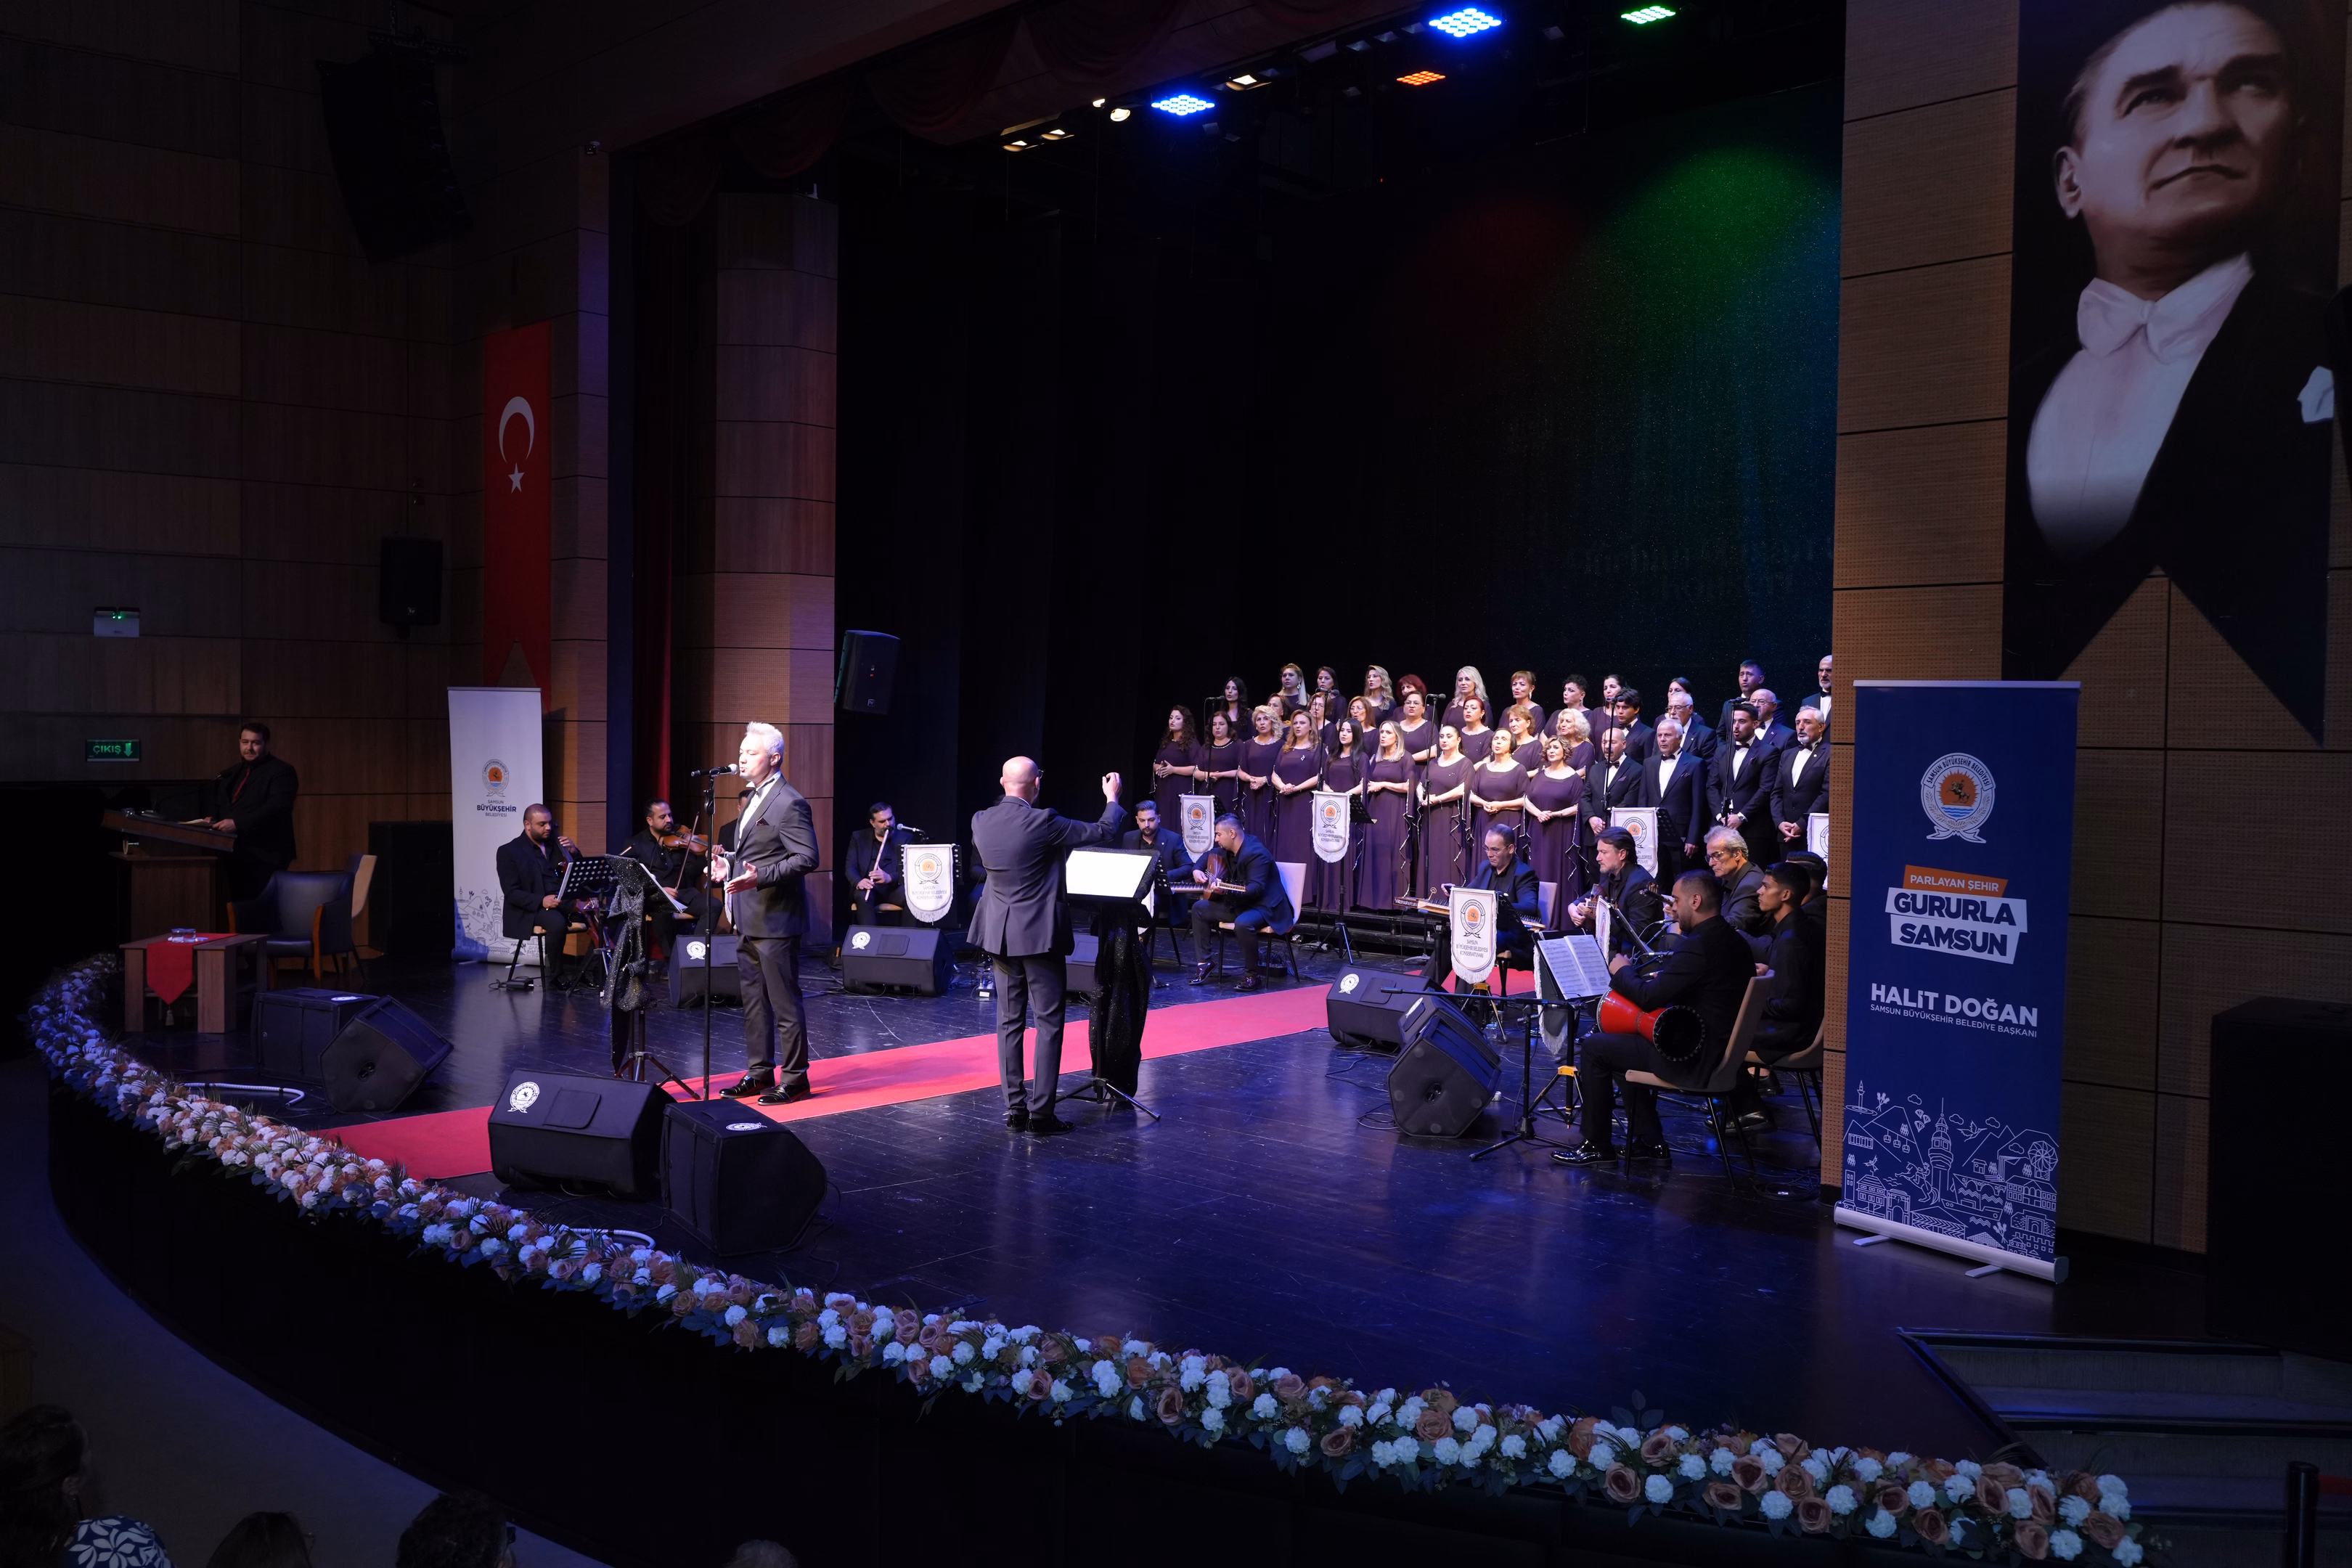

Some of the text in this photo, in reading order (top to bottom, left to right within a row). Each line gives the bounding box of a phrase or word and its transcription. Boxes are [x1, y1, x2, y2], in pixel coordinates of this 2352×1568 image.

[93, 745, 121, 754] ÇIKIŞ
[1927, 756, 1990, 786] SAMSUN BÜYÜKŞEHİR BELEDİYESİ
[477, 804, 517, 812] BÜYÜKŞEHİR
[1910, 875, 1999, 891] PARLAYAN ŞEHİR
[1894, 892, 2017, 926] GURURLA
[1900, 923, 2007, 956] SAMSUN
[1871, 983, 2038, 1027] HALİT DOĞAN
[1870, 1004, 2037, 1038] SAMSUN BÜYÜKŞEHİR BELEDİYE BAŞKANI
